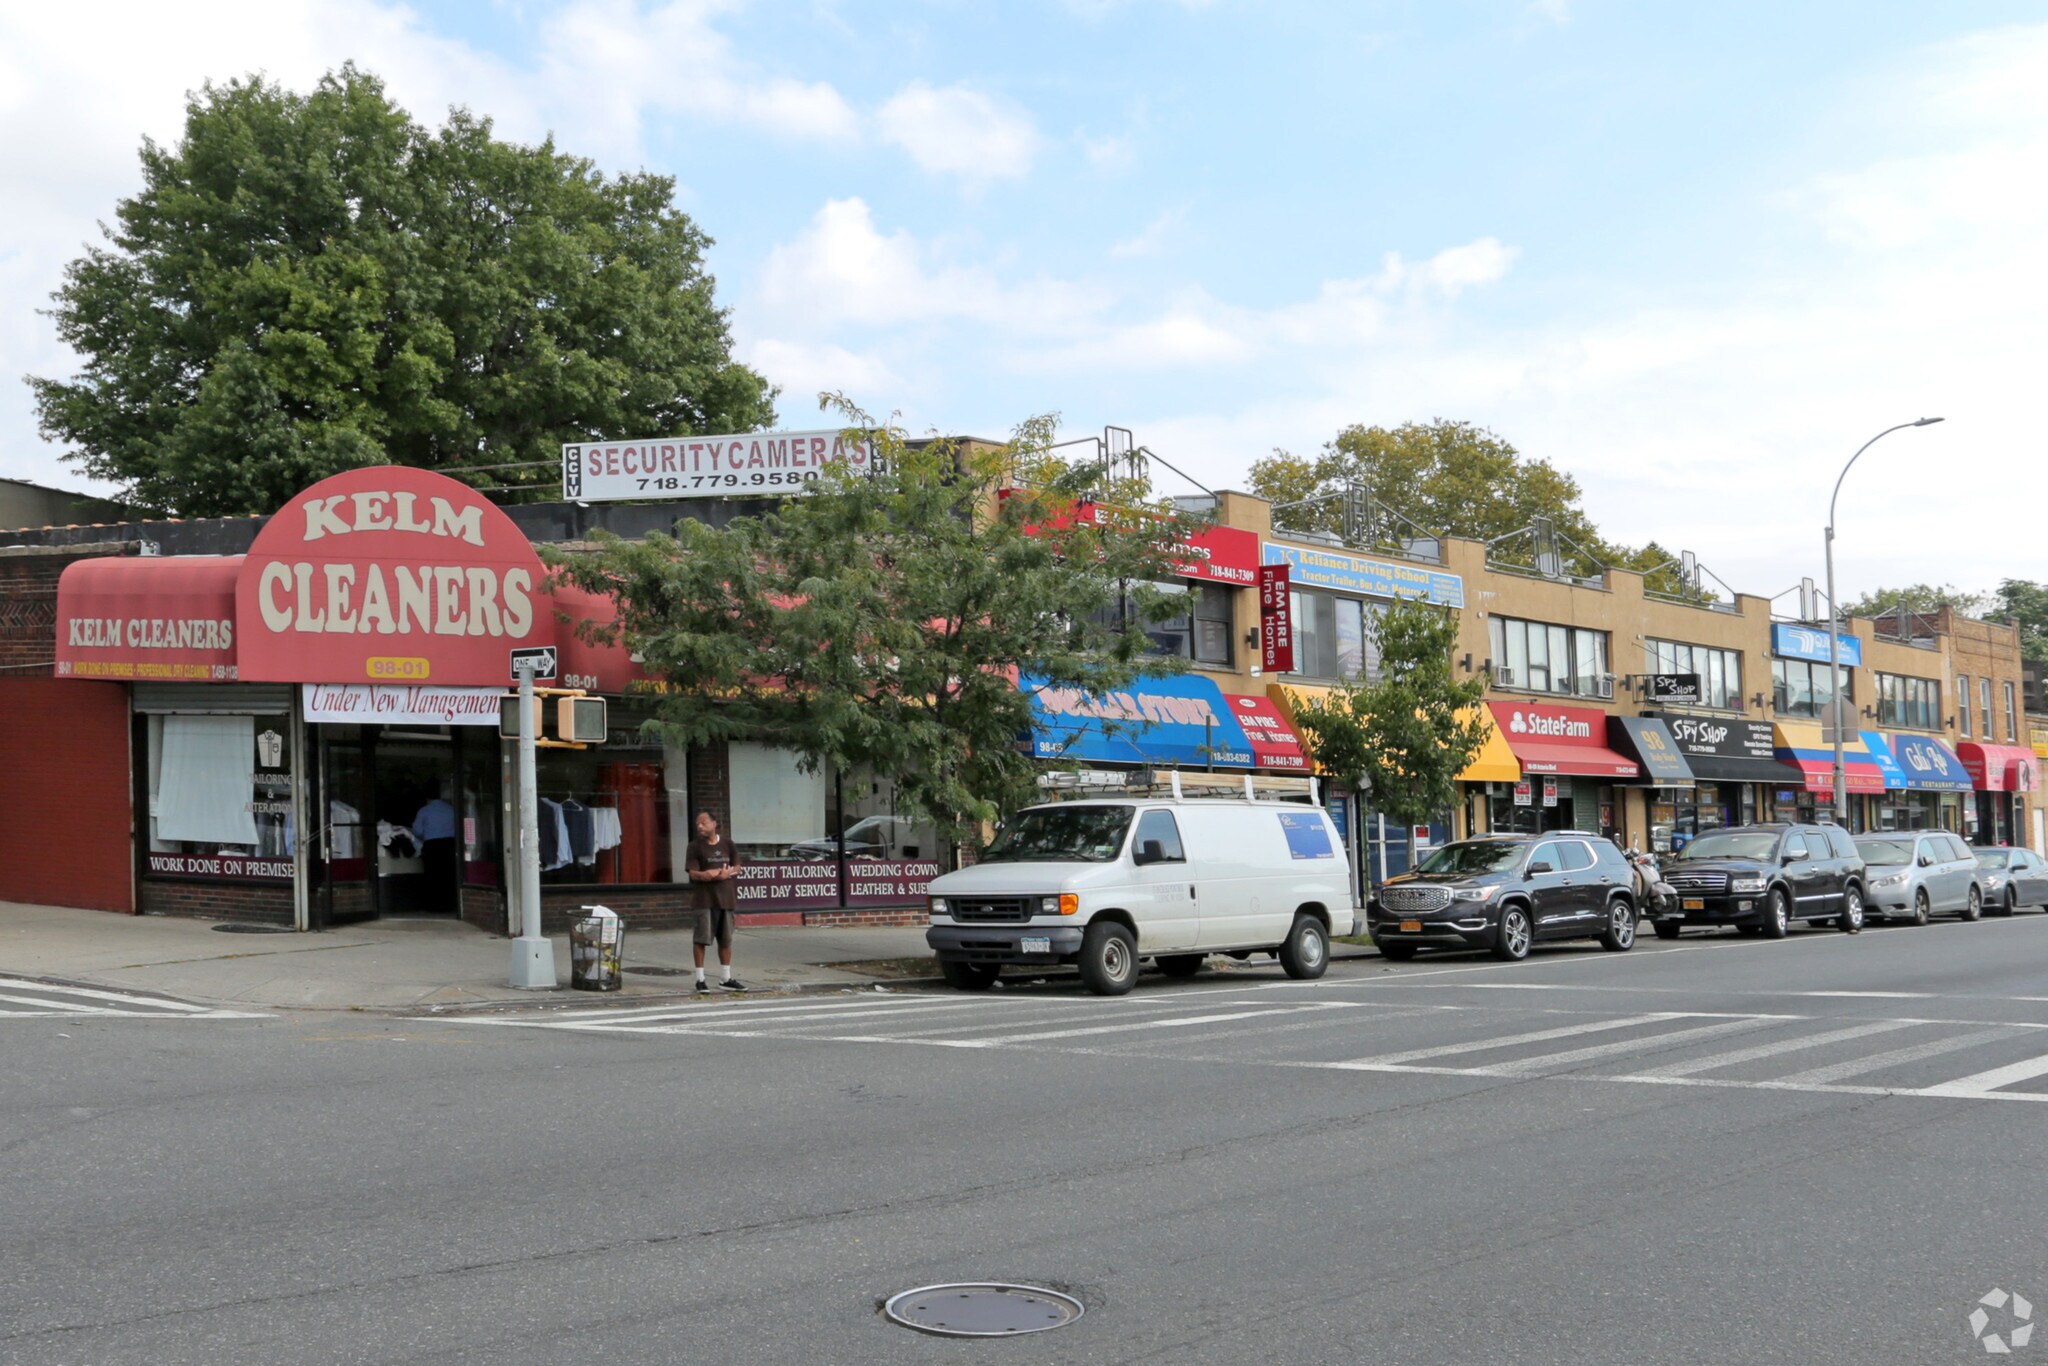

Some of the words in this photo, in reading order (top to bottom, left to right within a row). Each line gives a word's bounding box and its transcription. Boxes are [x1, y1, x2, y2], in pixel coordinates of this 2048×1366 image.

[567, 449, 580, 497] CCTV
[636, 470, 819, 491] 718.779.9580
[302, 490, 485, 546] KELM
[1300, 551, 1349, 570] Reliance
[1351, 559, 1392, 580] Driving
[1394, 567, 1429, 584] School
[1300, 569, 1331, 580] Tractor
[1263, 570, 1273, 605] Fine
[259, 561, 533, 639] CLEANERS
[1275, 581, 1288, 648] EMPIRE
[69, 618, 122, 647] KELM
[126, 619, 232, 650] CLEANERS
[1265, 615, 1276, 666] Homes
[372, 660, 425, 676] 98-01
[537, 656, 552, 669] WAY
[564, 673, 598, 689] 98-01
[1656, 676, 1677, 687] SPY
[1668, 684, 1696, 695] SHOP
[311, 683, 361, 712] Under
[362, 684, 401, 713] New
[400, 686, 501, 722] Managemen
[1238, 714, 1279, 729] EMPIRE
[1242, 727, 1266, 741] Fine
[1266, 729, 1298, 743] Homes
[1673, 719, 1698, 743] SPY
[1698, 721, 1728, 744] SHOP
[1640, 730, 1665, 750] 98
[267, 788, 274, 799] &
[243, 802, 293, 814] ALTERATION
[150, 856, 185, 872] WORK
[188, 858, 221, 874] DONE
[223, 860, 242, 875] ON
[246, 861, 295, 877] PREMISE
[737, 865, 777, 879] EXPERT
[779, 864, 837, 878] TAILORING
[849, 863, 902, 877] WEDDING
[904, 863, 938, 876] GOWN
[737, 885, 768, 899] SAME
[770, 884, 792, 898] DAY
[794, 883, 837, 897] SERVICE
[850, 883, 895, 895] LEATHER
[897, 883, 905, 895] &
[908, 882, 931, 895] SUE
